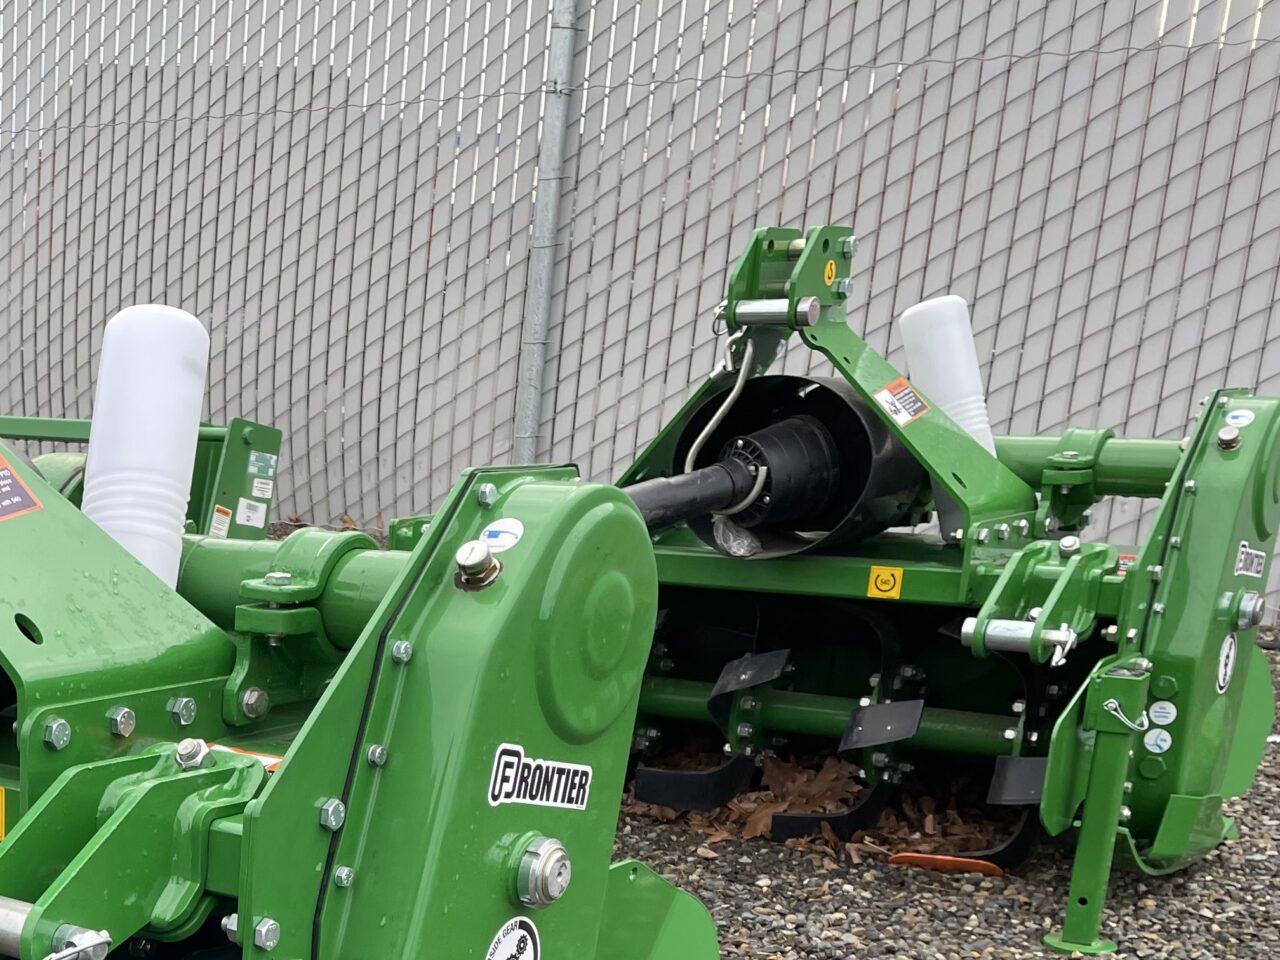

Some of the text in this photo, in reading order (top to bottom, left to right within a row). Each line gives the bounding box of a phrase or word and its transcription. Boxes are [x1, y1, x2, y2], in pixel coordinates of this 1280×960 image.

[491, 748, 589, 805] FRONTIER
[489, 920, 519, 959] SIDE GEAR
